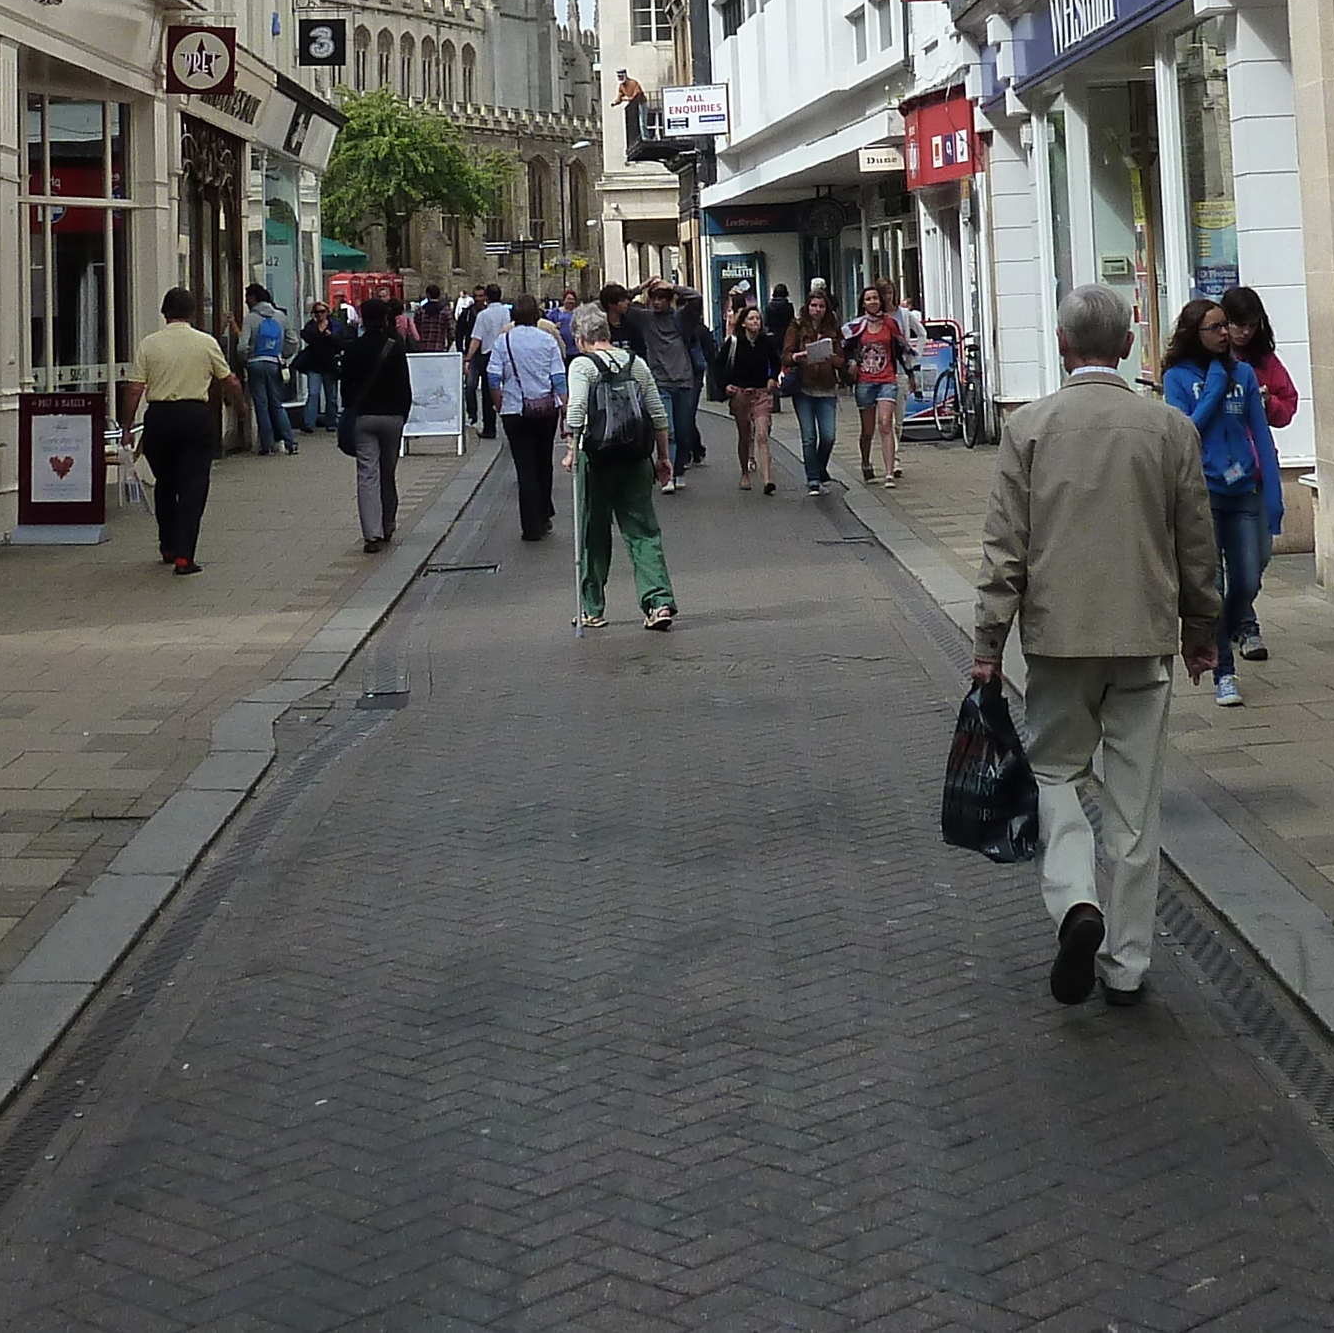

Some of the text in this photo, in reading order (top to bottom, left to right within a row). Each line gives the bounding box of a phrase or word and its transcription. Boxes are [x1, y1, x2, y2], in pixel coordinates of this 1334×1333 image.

[309, 26, 335, 59] 3
[184, 51, 217, 73] PRET
[686, 94, 705, 103] ALL
[669, 103, 722, 115] ENQUIRIES
[867, 156, 897, 164] Dune
